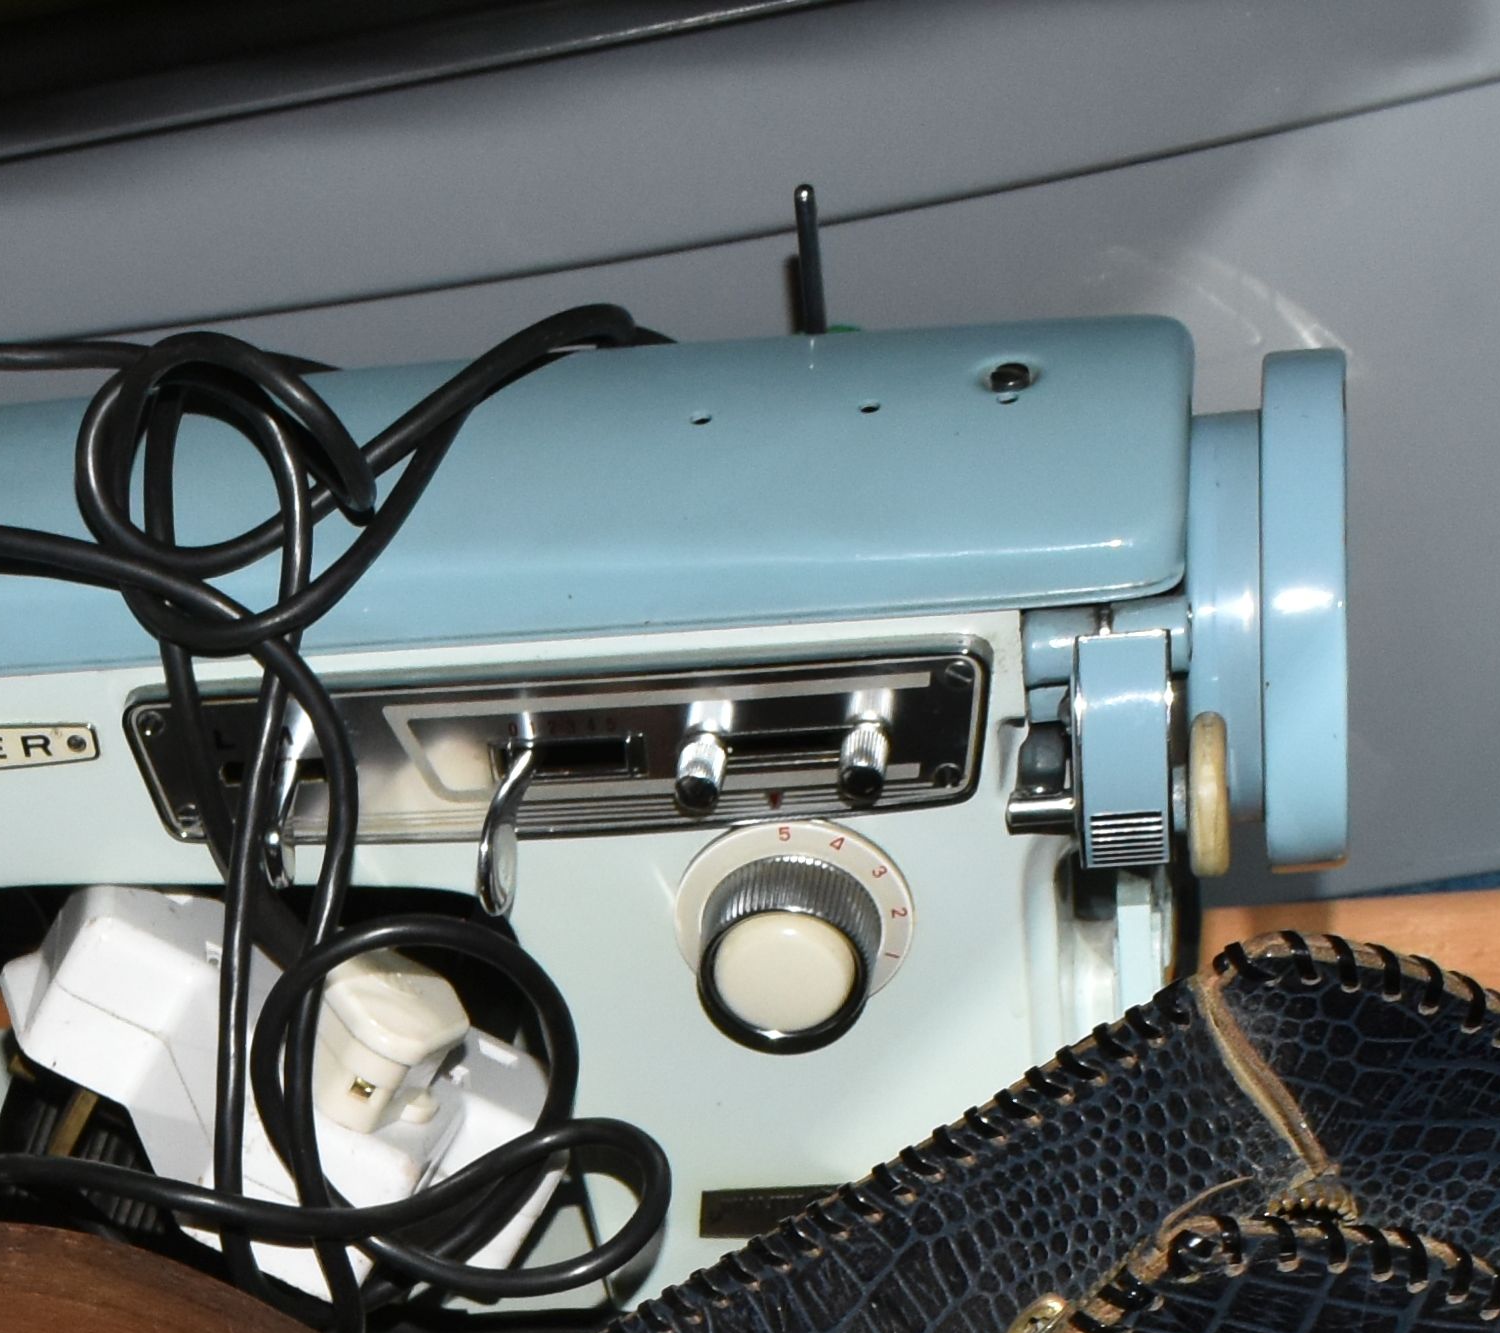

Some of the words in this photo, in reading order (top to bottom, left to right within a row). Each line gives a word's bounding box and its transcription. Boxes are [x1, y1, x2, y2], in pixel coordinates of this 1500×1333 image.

[778, 826, 791, 842] 5
[829, 836, 846, 850] 4
[871, 864, 889, 879] 3
[890, 906, 908, 919] 2
